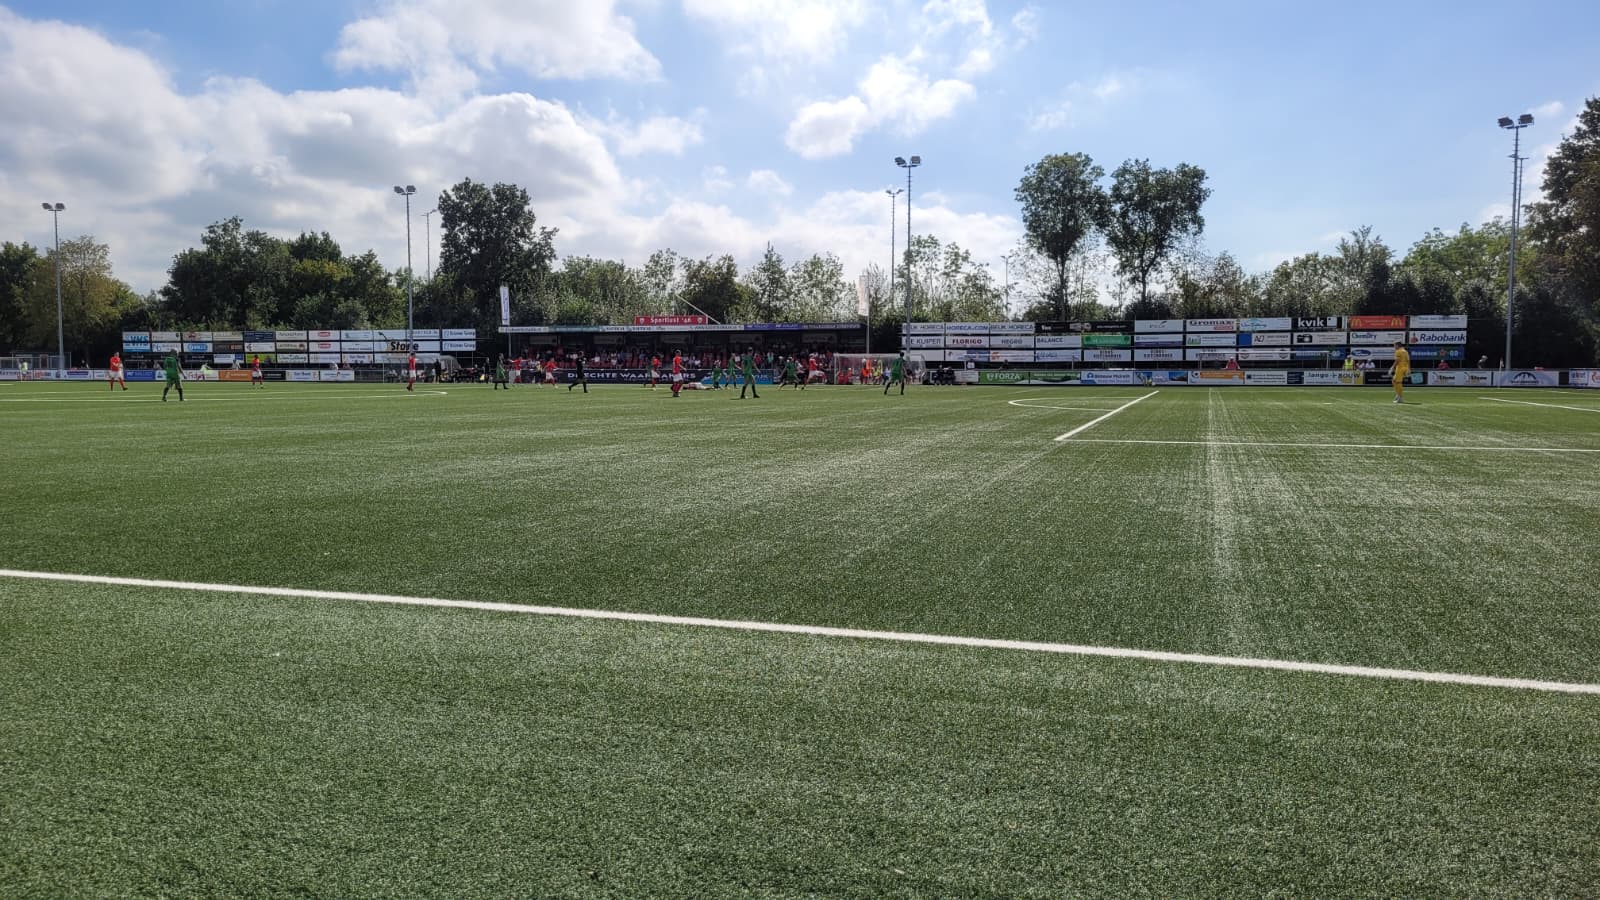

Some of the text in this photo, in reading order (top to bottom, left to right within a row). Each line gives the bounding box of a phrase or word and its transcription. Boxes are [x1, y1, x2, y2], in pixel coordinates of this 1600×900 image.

[650, 316, 679, 324] Sportlust
[1298, 317, 1324, 327] kvik
[1420, 333, 1466, 341] Rabobank
[995, 371, 1021, 380] FORZA
